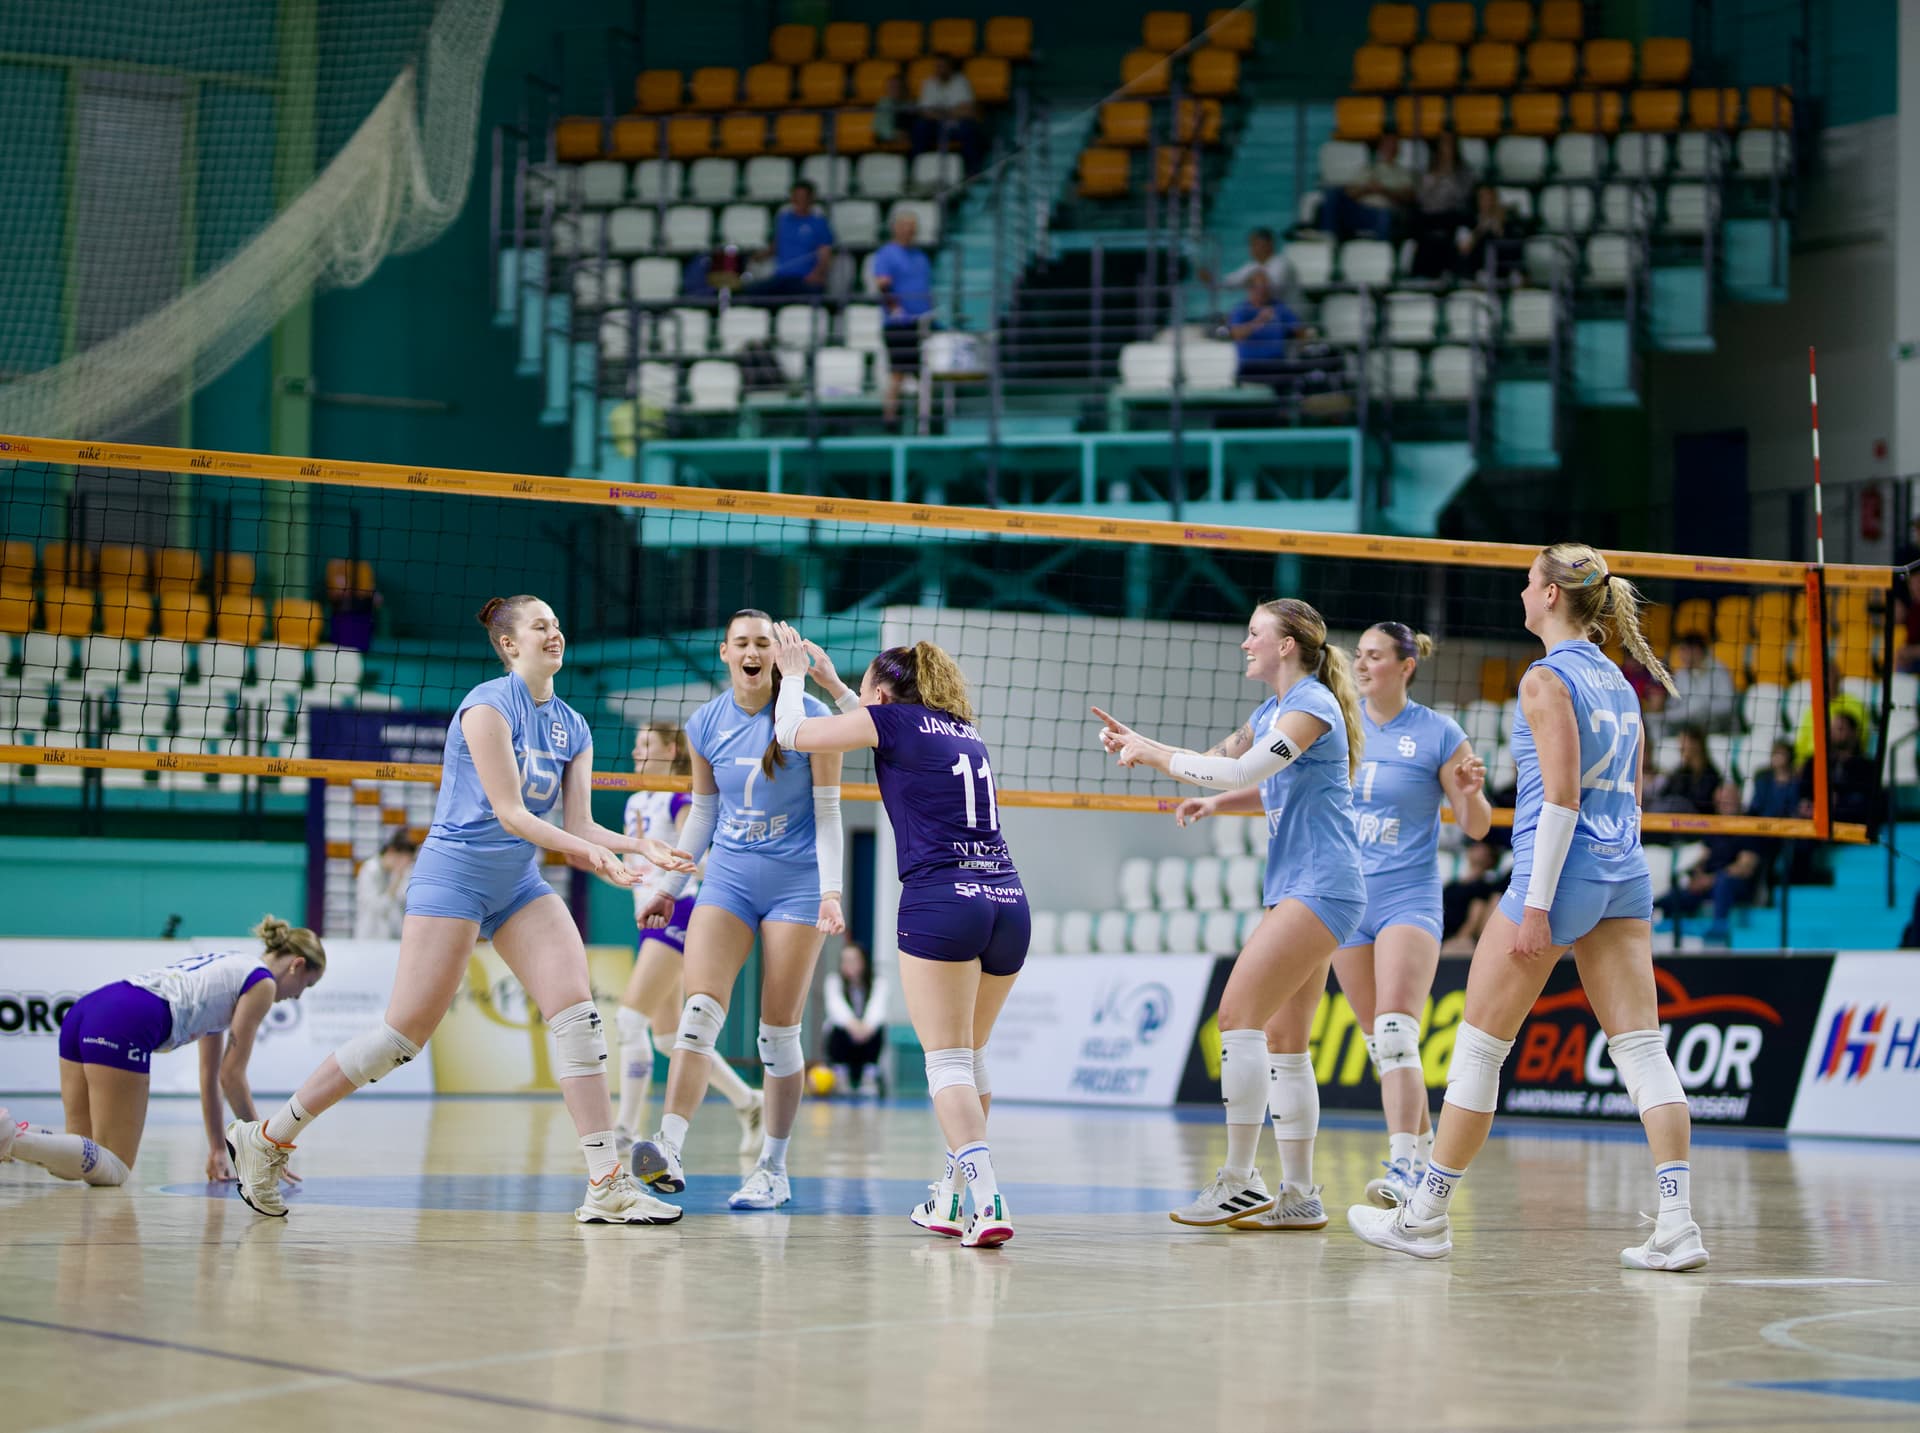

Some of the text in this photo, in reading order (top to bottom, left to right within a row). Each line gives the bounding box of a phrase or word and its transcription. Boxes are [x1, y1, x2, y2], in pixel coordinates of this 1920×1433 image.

[551, 721, 568, 748] SB
[1581, 709, 1640, 793] 22
[735, 757, 763, 808] 7
[951, 753, 998, 831] 11
[1427, 1172, 1451, 1198] SB
